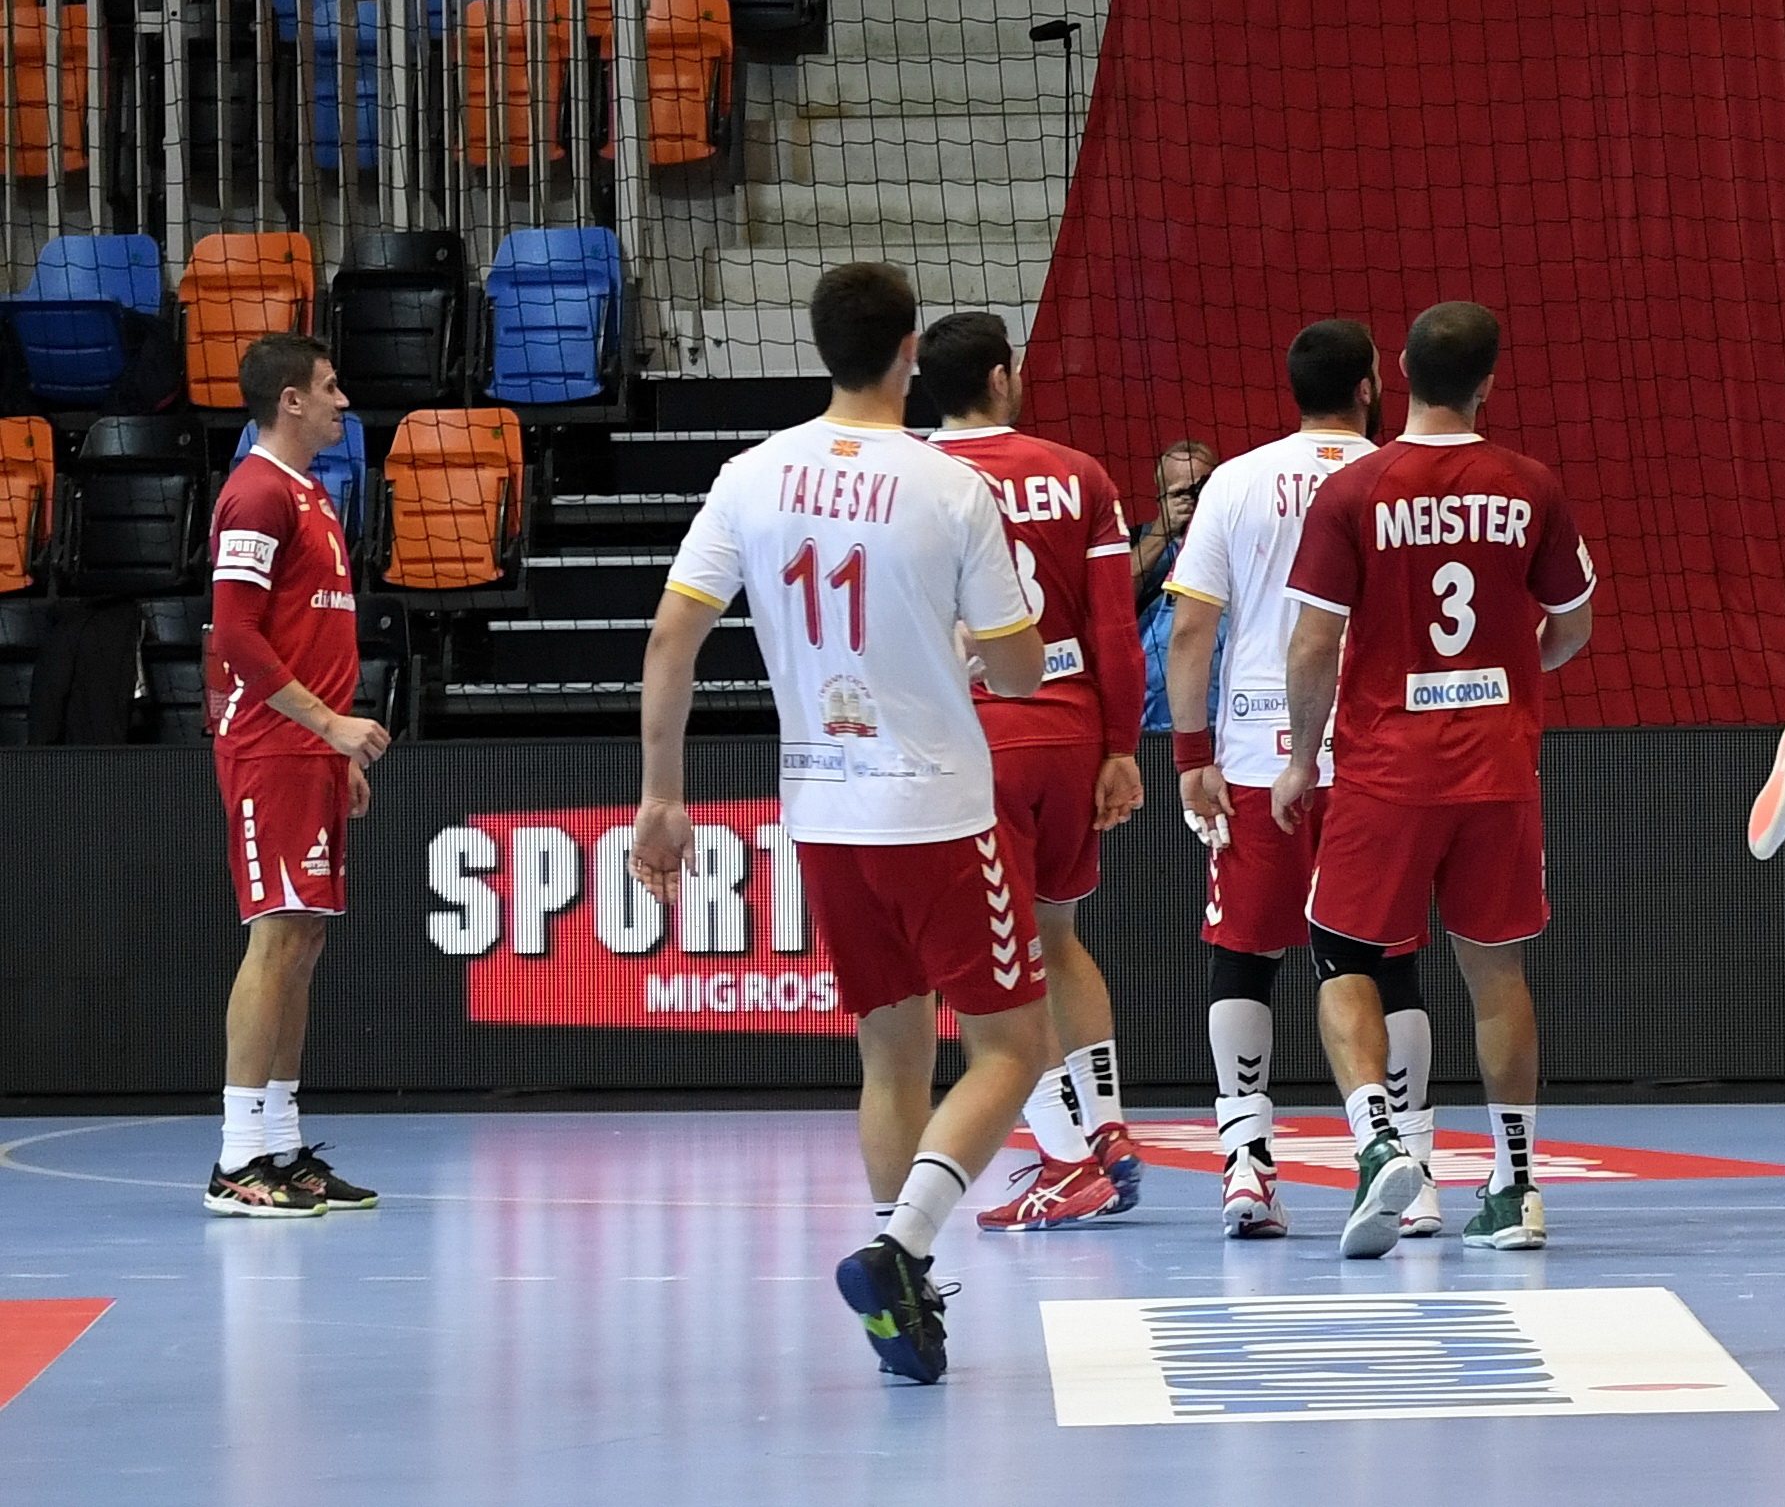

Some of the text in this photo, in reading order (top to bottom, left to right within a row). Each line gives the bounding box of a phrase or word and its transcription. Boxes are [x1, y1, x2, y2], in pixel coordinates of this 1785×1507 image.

[778, 464, 899, 525] TALESKI
[1002, 474, 1083, 524] LEN
[1375, 494, 1532, 550] MEISTER
[780, 536, 867, 657] 11
[1429, 561, 1477, 657] 3
[1250, 697, 1289, 712] EURO-F
[1413, 674, 1504, 705] CONCORDIA
[429, 824, 805, 956] SPORT
[647, 972, 839, 1013] MIGROS
